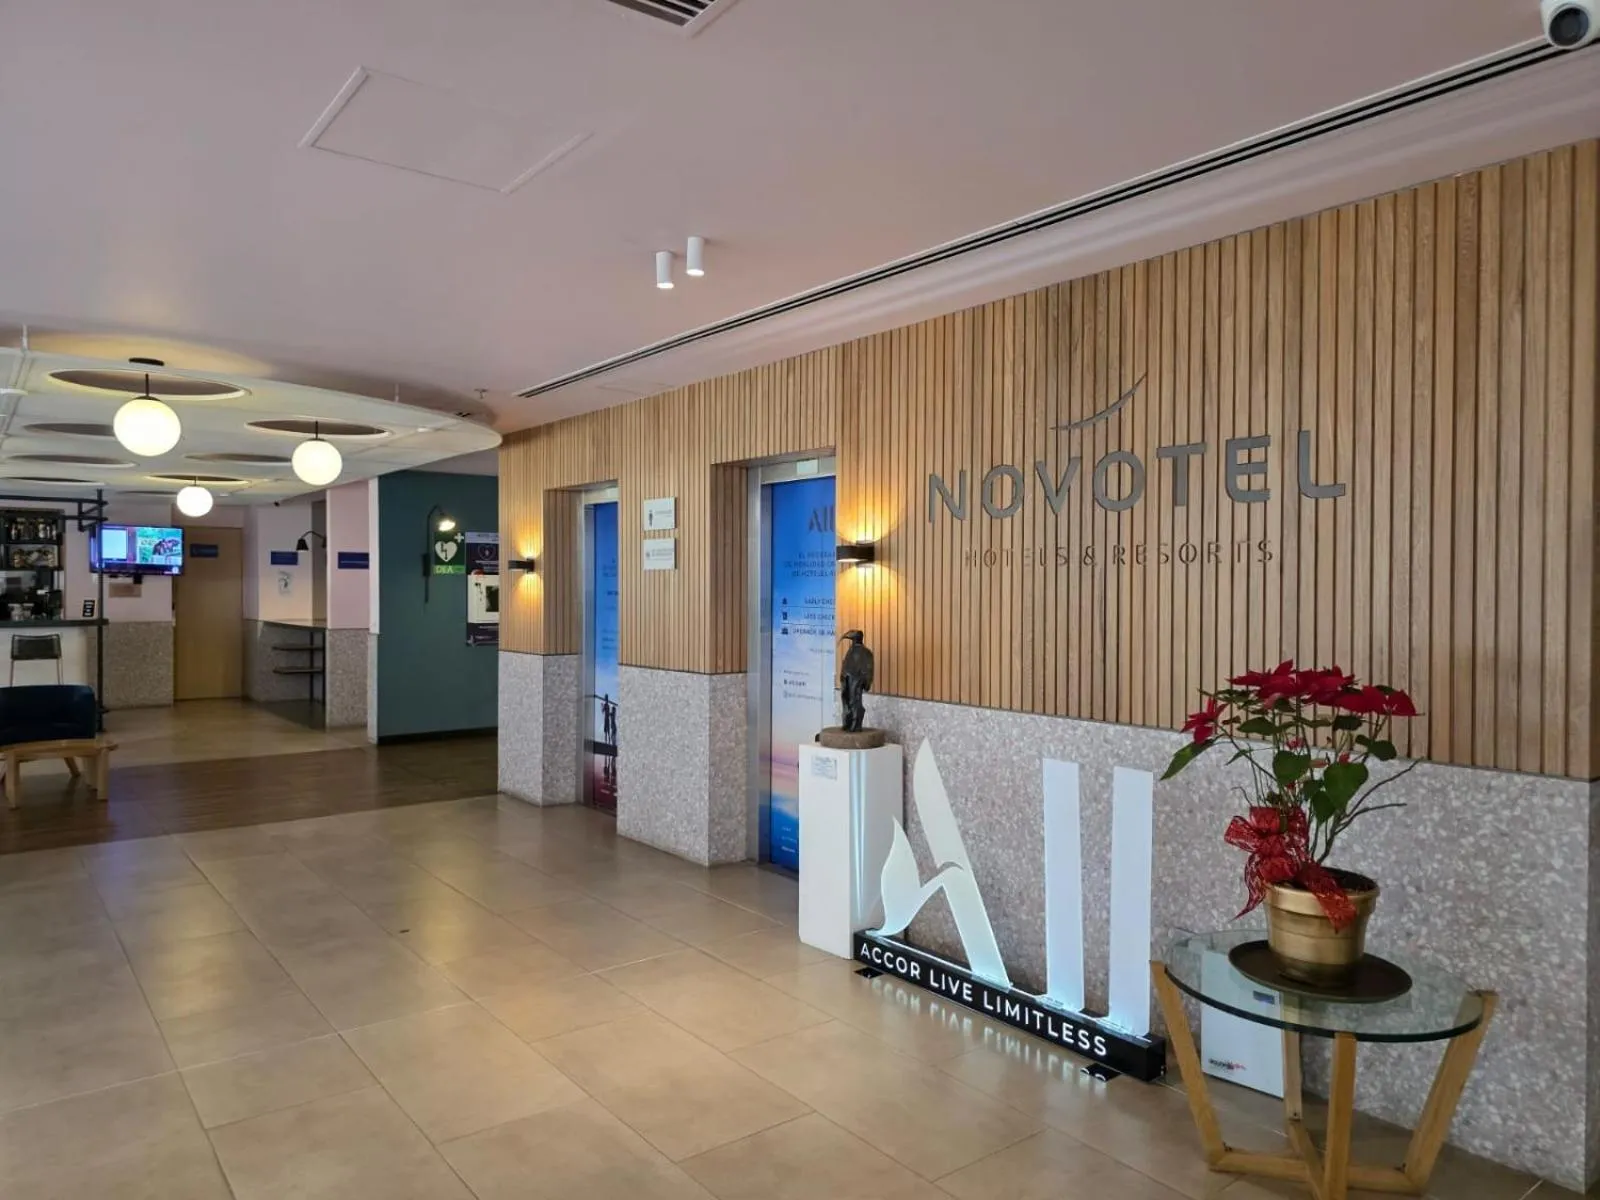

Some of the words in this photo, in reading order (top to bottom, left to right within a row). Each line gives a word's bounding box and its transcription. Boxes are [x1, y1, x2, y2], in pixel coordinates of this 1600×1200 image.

[928, 430, 1346, 524] NOVOTEL
[964, 546, 1069, 568] HOTELS
[1082, 545, 1097, 566] &
[1112, 540, 1273, 566] RESORTS
[860, 942, 921, 980] ACCOR
[929, 969, 973, 1002] LIVE
[983, 990, 1107, 1057] LIMITLESS
